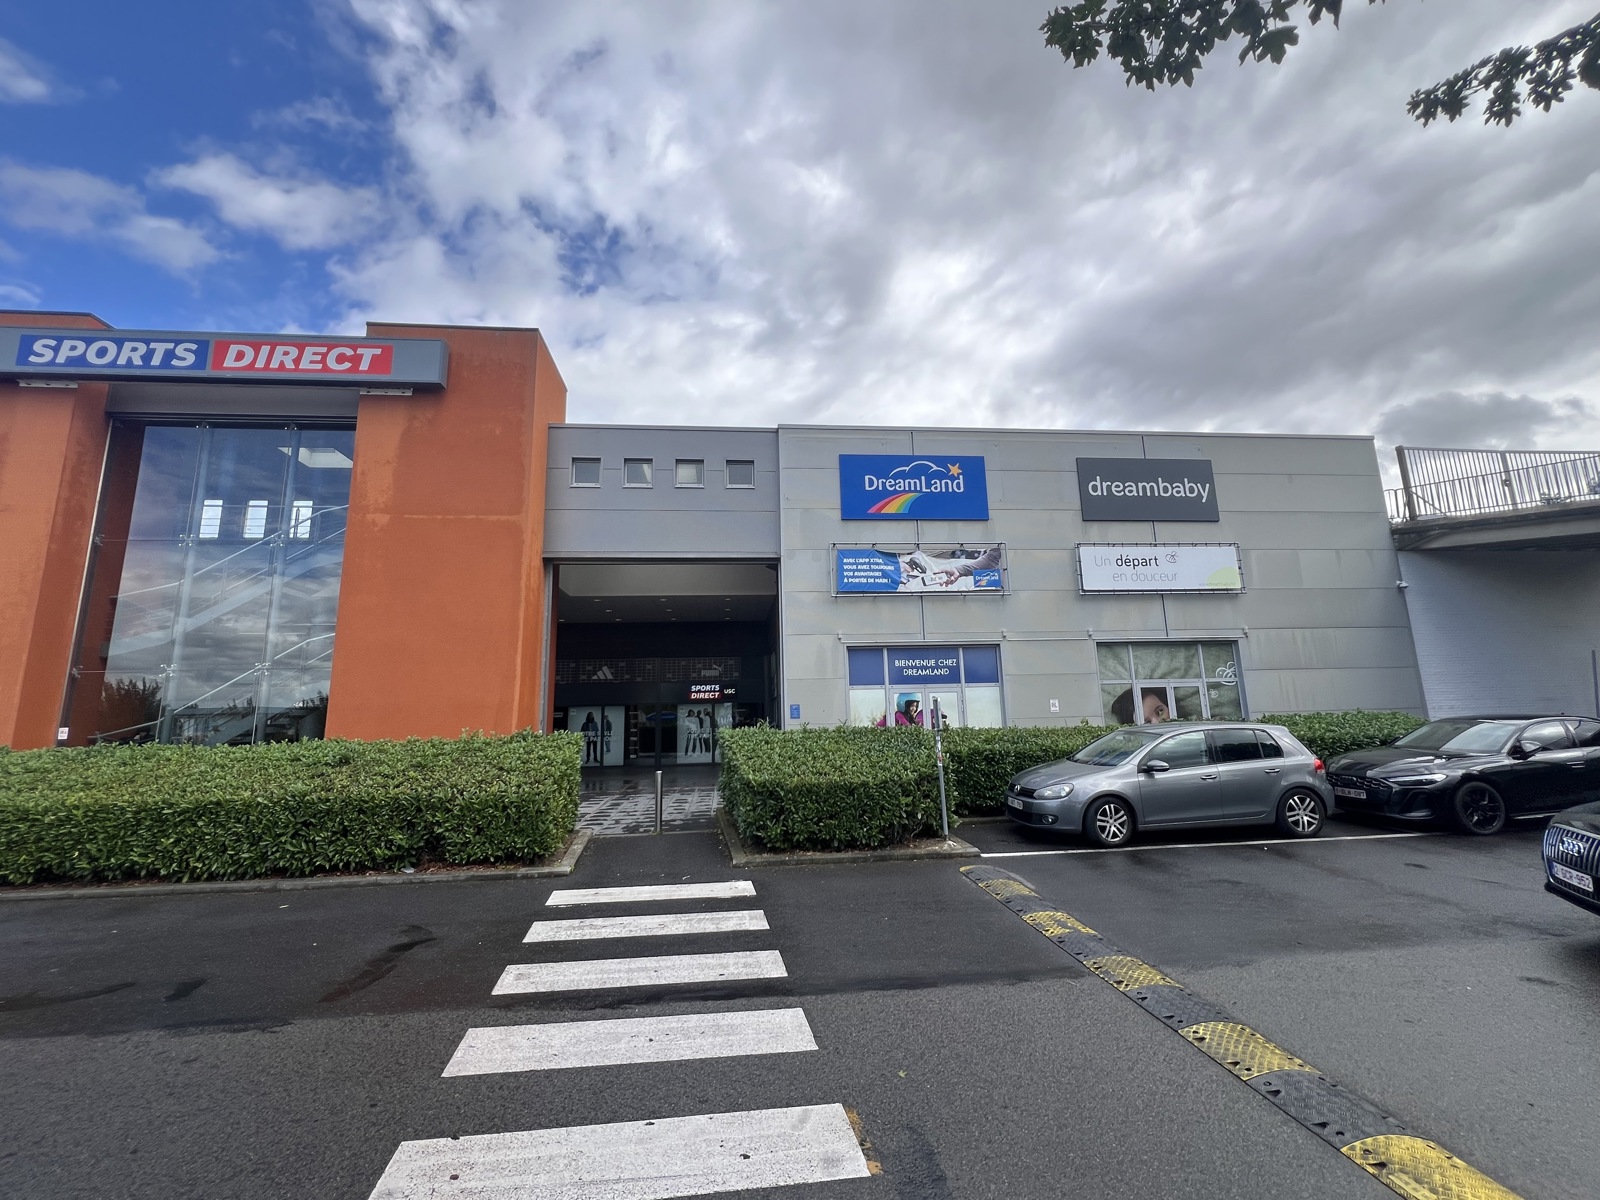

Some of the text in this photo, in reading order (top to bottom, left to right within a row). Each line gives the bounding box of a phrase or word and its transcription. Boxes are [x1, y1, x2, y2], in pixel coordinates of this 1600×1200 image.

[27, 338, 384, 371] SPORTS DIRECT
[864, 474, 964, 493] DreamLand
[1088, 475, 1210, 503] dreambaby
[1094, 554, 1159, 569] Un départ
[1112, 570, 1179, 582] en douceur
[894, 658, 957, 667] BIENVENUE CHEZ
[903, 668, 950, 676] DREAMLAND
